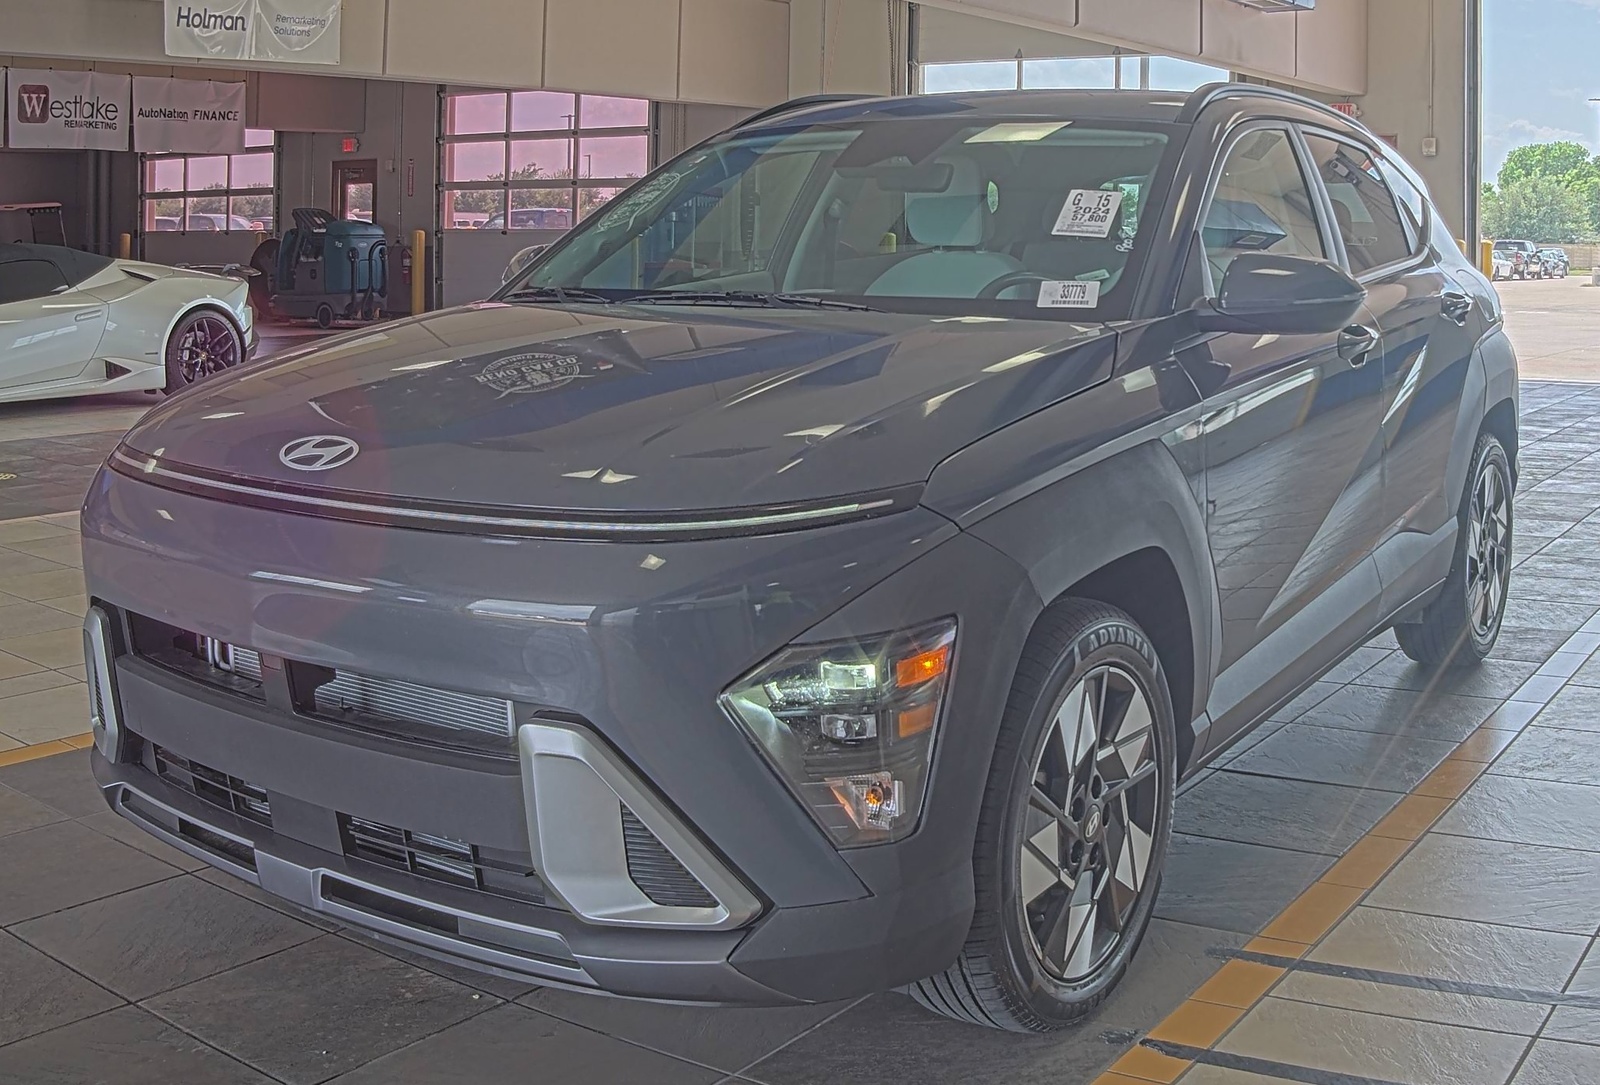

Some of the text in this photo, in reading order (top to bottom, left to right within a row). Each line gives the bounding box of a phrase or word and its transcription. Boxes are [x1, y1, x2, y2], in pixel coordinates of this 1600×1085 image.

[176, 7, 246, 31] Holman
[275, 14, 326, 28] Remarketing
[273, 26, 311, 37] Solutions
[20, 93, 118, 121] Westlake
[137, 103, 239, 121] AutoNation FINANCE
[64, 119, 118, 131] REMARKETING
[1072, 192, 1112, 208] G 15
[1072, 206, 1111, 215] 2024
[1060, 284, 1087, 299] 337779
[1088, 626, 1149, 659] ADVANTA
